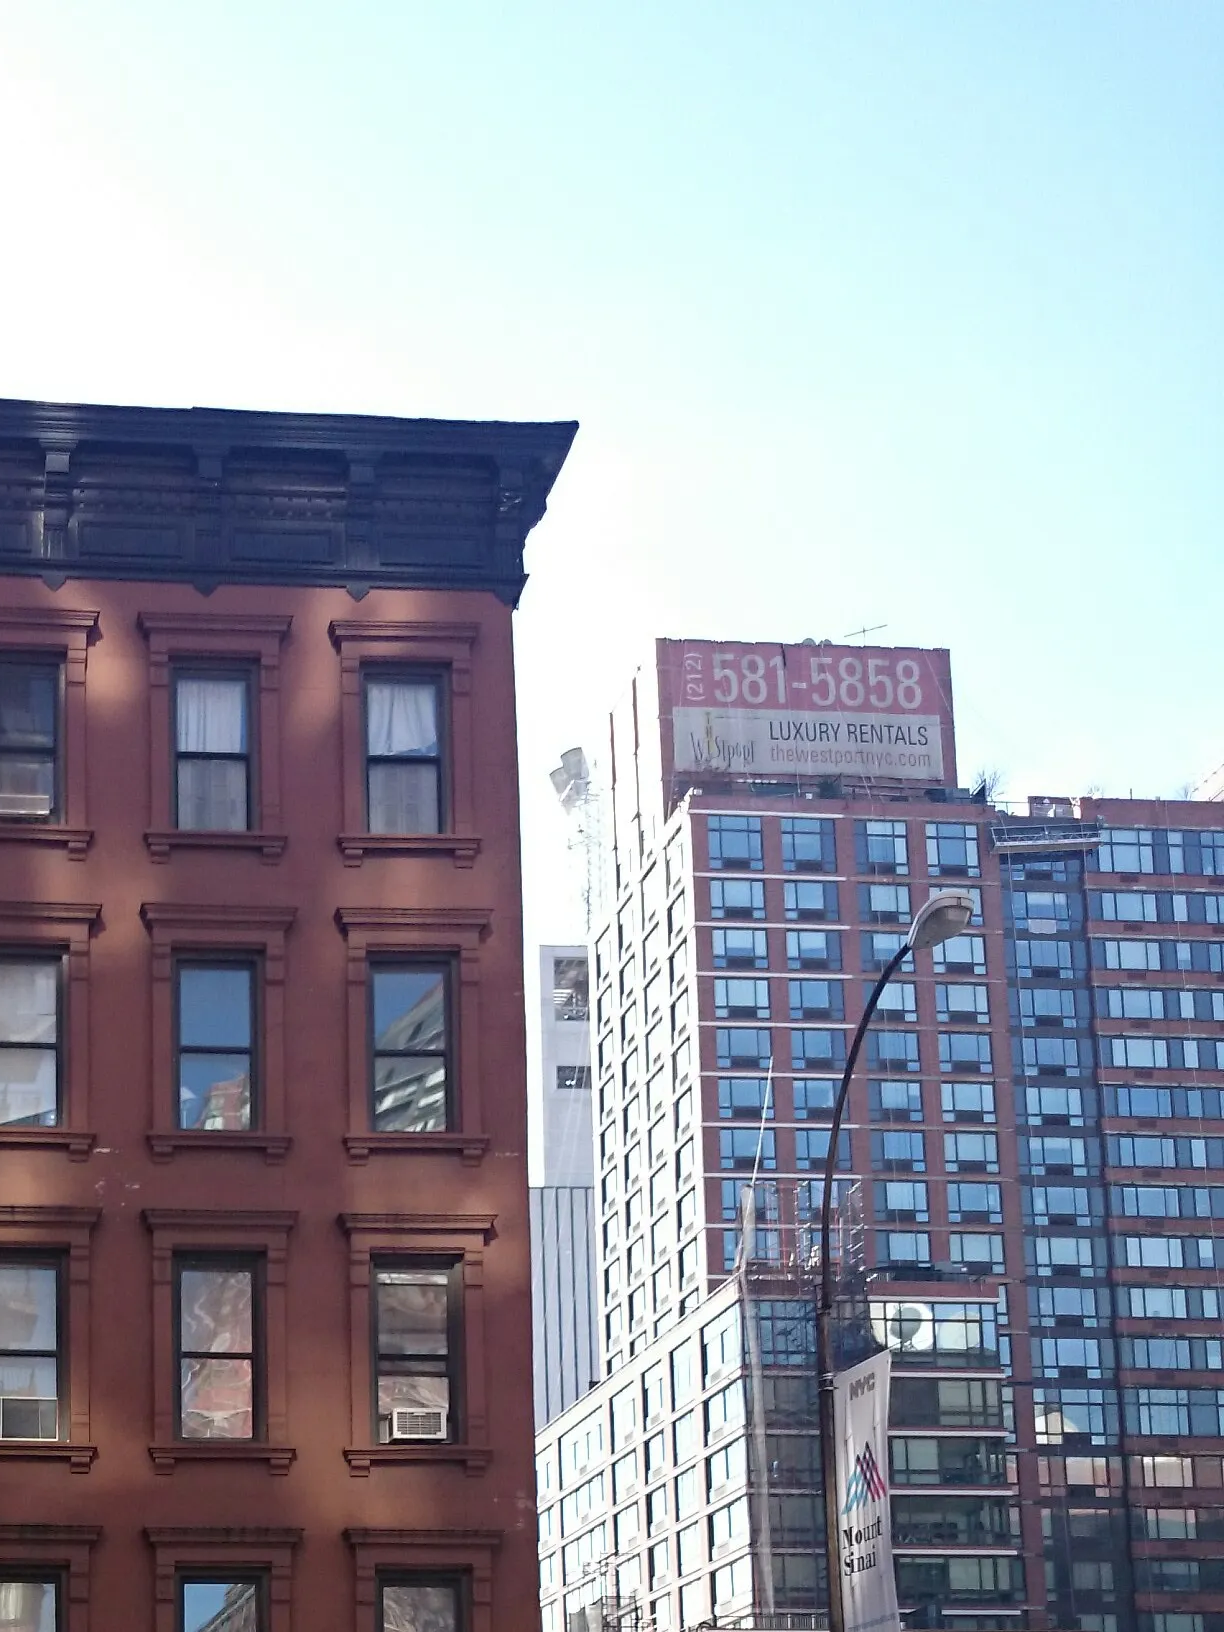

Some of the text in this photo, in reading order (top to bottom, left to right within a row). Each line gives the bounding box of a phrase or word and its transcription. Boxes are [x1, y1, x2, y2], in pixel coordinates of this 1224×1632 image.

[684, 652, 922, 709] (212) 581-5858
[769, 721, 929, 746] LUXURY RENTALS
[770, 744, 931, 768] thewestportnyc.com
[849, 1372, 875, 1400] NYC
[841, 1516, 882, 1549] Mount
[843, 1544, 877, 1576] Sinai
